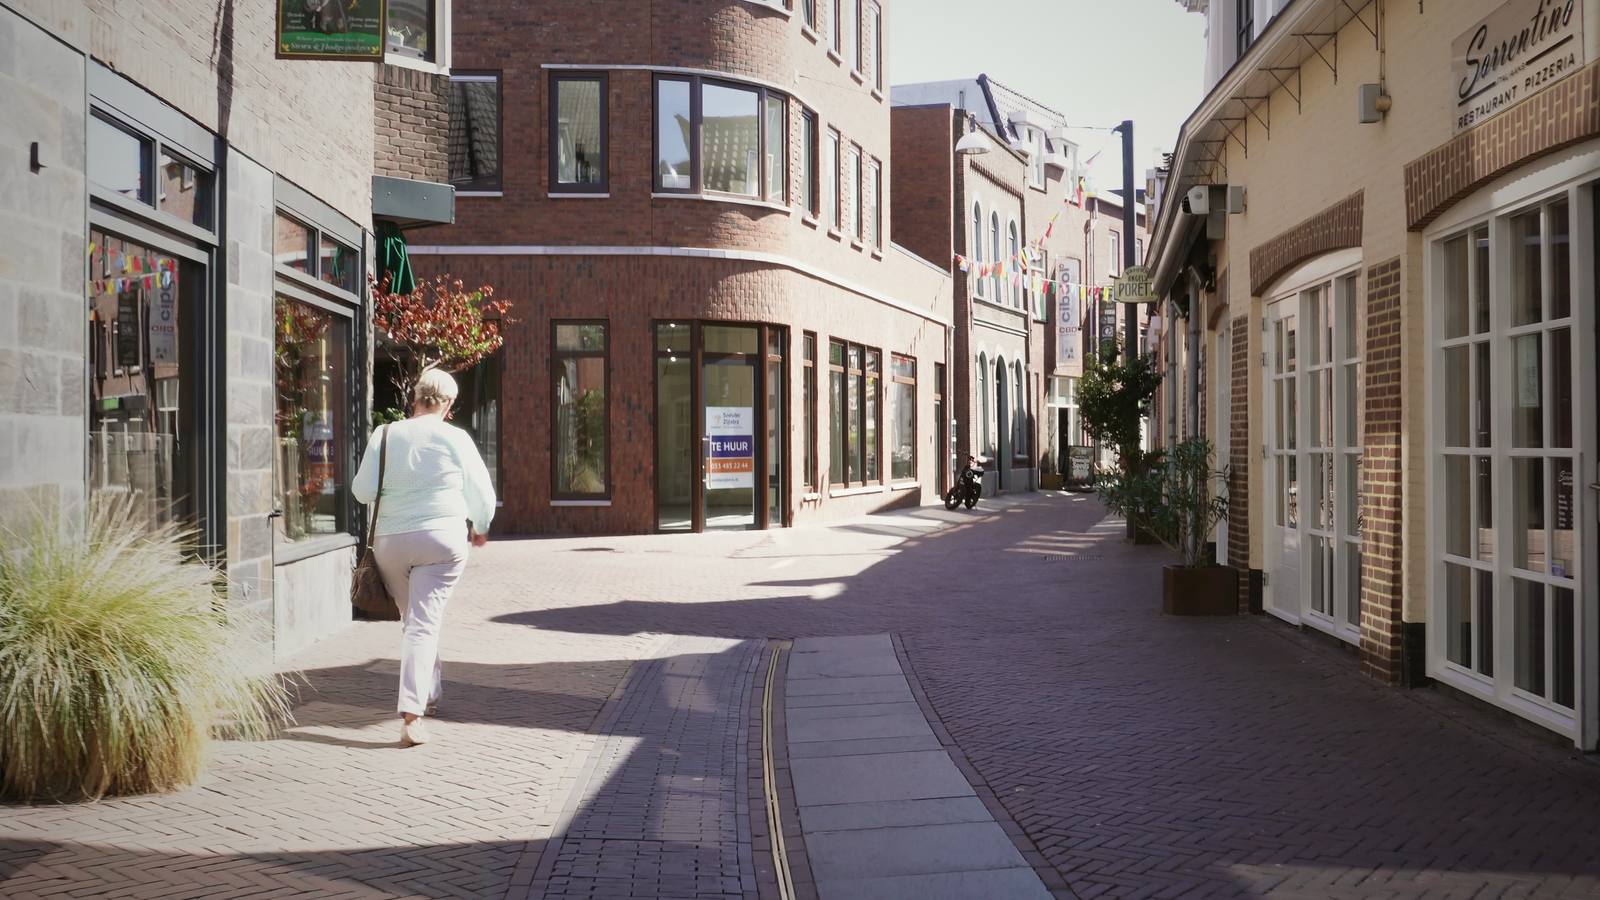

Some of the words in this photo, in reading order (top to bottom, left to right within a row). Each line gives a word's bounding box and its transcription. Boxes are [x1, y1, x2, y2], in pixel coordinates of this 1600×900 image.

[1459, 0, 1574, 99] Sorrentino
[1458, 85, 1518, 129] RESTAURANT
[1524, 53, 1575, 91] PIZZERIA
[711, 442, 722, 451] TE
[724, 442, 748, 451] HUUR
